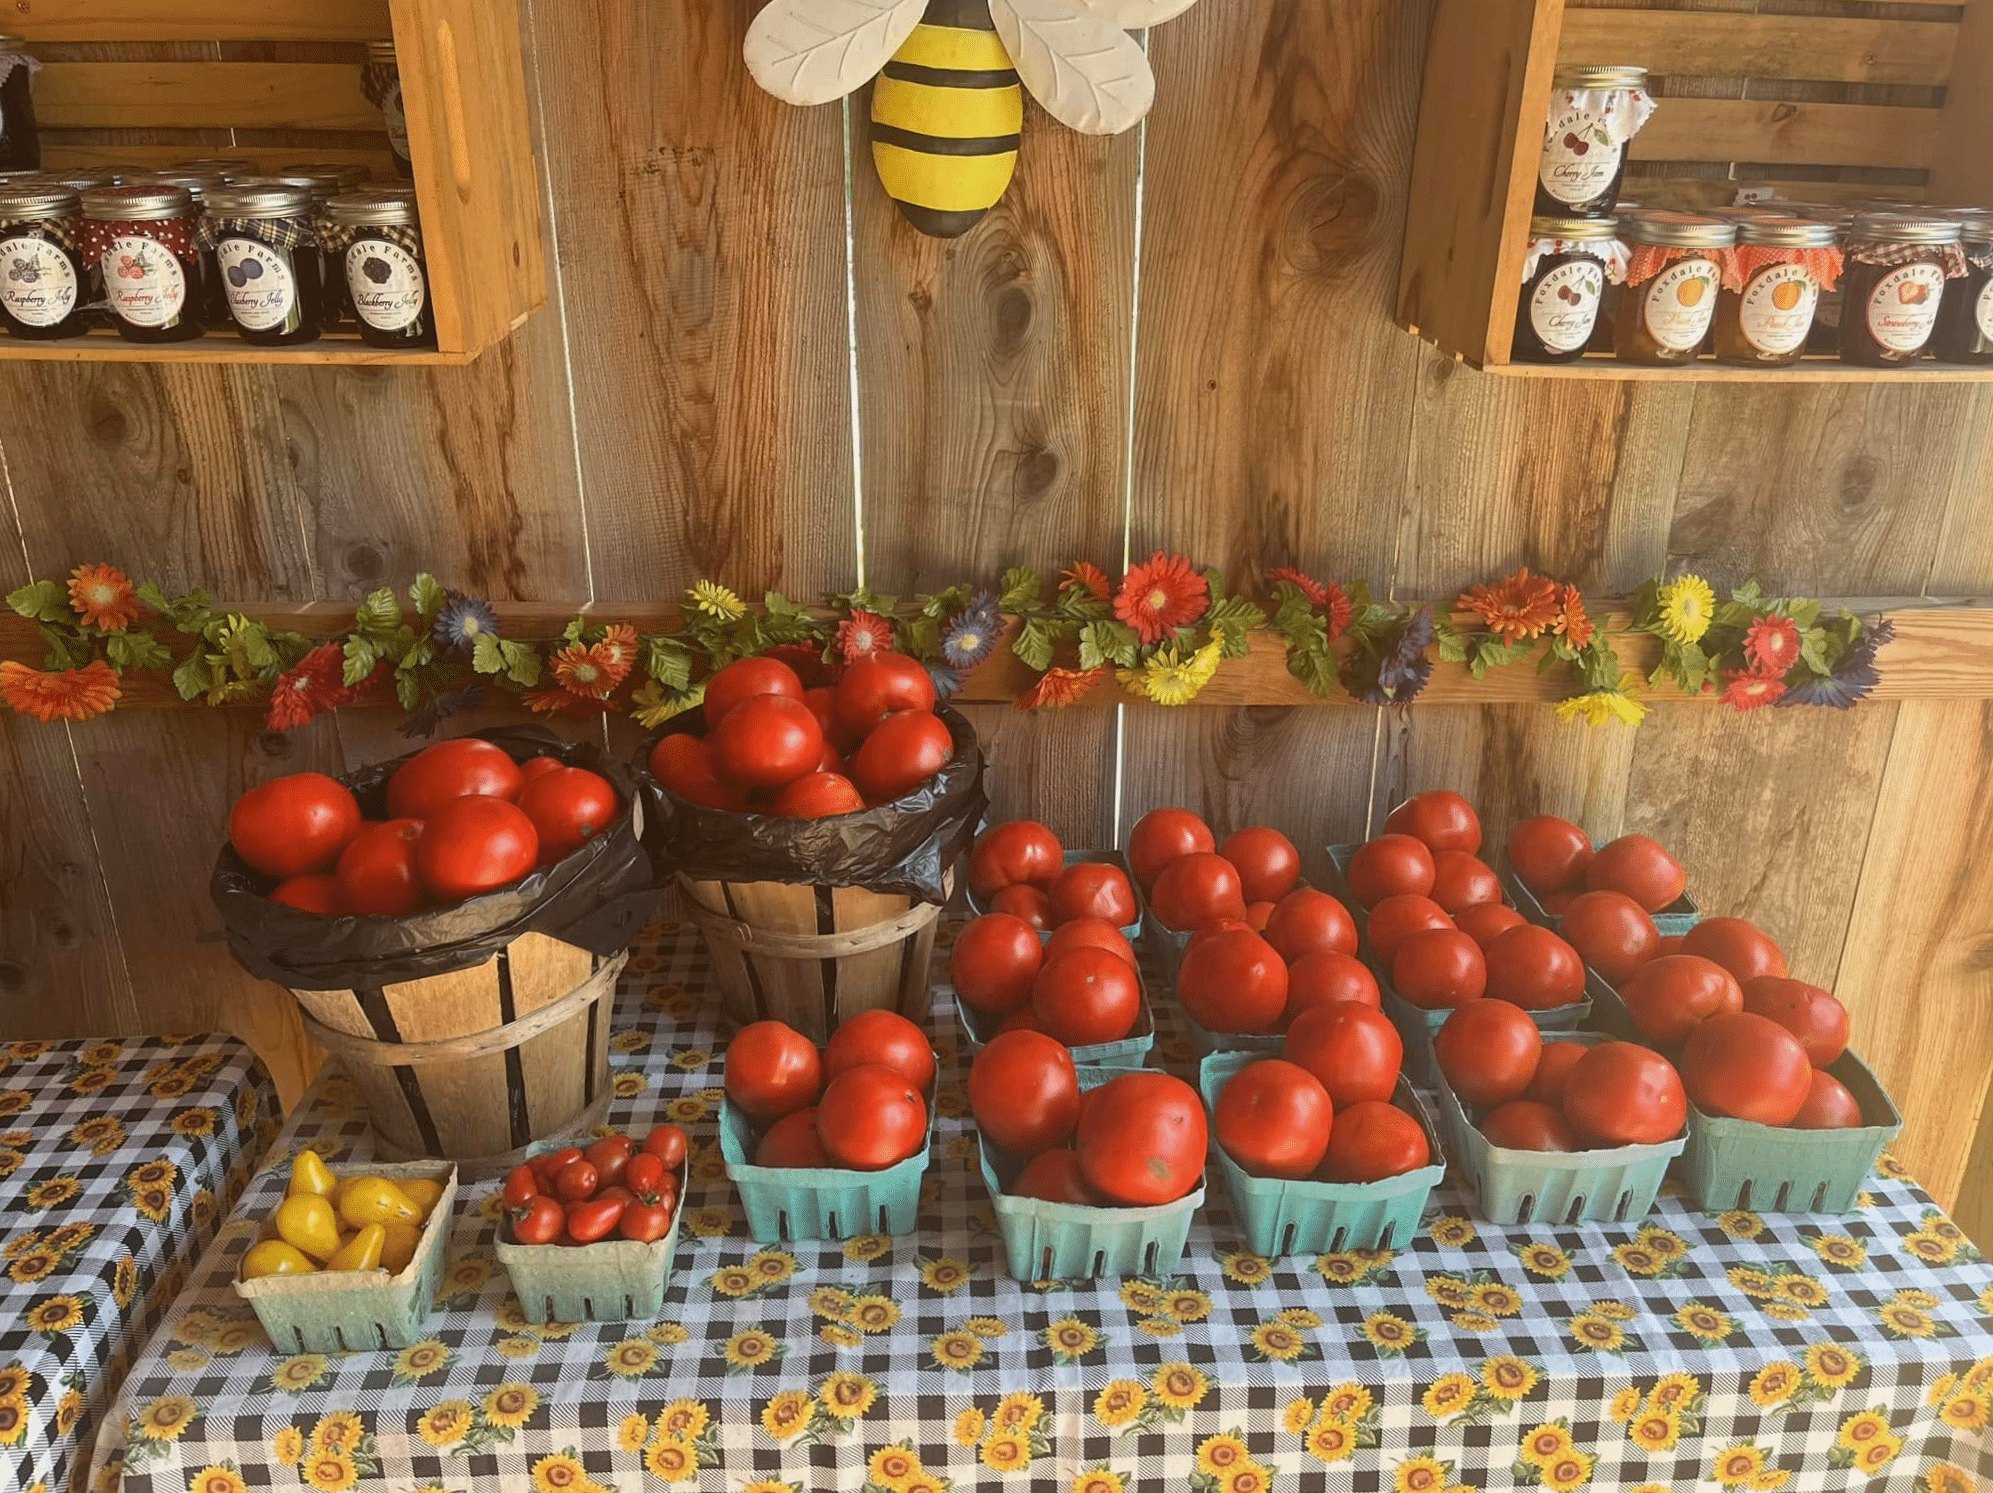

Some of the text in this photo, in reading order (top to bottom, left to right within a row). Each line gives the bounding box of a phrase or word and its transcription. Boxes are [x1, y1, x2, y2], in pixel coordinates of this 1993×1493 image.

[1553, 162, 1581, 182] Cherry
[384, 245, 418, 281] Farms
[4, 289, 47, 307] Raspberry
[115, 288, 154, 306] Raspberry
[260, 289, 284, 307] Jelly
[1535, 266, 1582, 305] Foxdale
[1651, 266, 1702, 303] Foxdale
[1746, 269, 1798, 305] Foxdale
[1873, 268, 1925, 305] Foxdale
[357, 292, 393, 310] Blackberry
